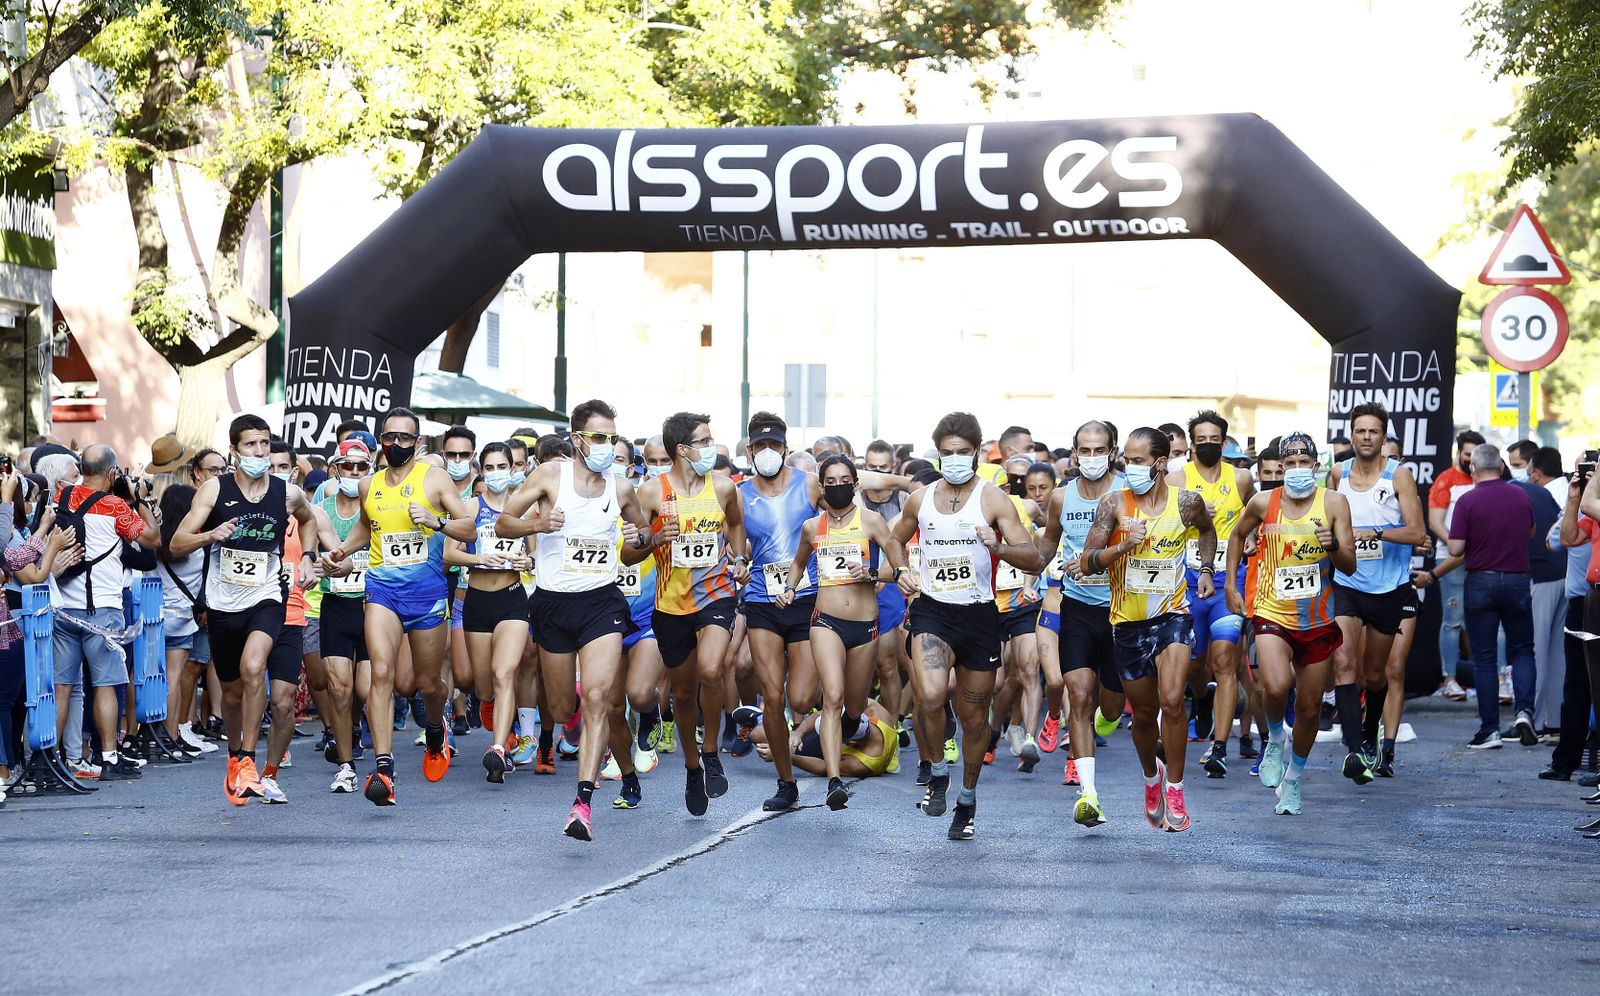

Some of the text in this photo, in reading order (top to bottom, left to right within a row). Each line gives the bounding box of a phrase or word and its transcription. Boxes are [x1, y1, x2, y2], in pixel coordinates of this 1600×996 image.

[542, 124, 1183, 241] alssport.es
[679, 223, 776, 243] TIENDA
[803, 222, 928, 242] RUNNING
[950, 220, 1031, 239] TRAIL
[1052, 215, 1191, 237] OUTDOOR
[1501, 314, 1547, 341] 30
[289, 345, 393, 385] TIENDA
[1332, 349, 1442, 385] TIENDA
[285, 381, 391, 413] RUNNING
[1329, 386, 1441, 414] RUNNING
[697, 516, 720, 529] Álora
[1066, 508, 1095, 523] nerj
[390, 541, 424, 557] 617
[494, 539, 515, 552] 47
[1156, 535, 1181, 549] Álora
[1355, 539, 1379, 551] 46
[572, 549, 608, 564] 472
[681, 543, 715, 558] 187
[232, 560, 256, 576] 32
[835, 556, 846, 570] 2
[935, 565, 972, 582] 458
[1147, 570, 1160, 584] 7
[1283, 574, 1315, 591] 211
